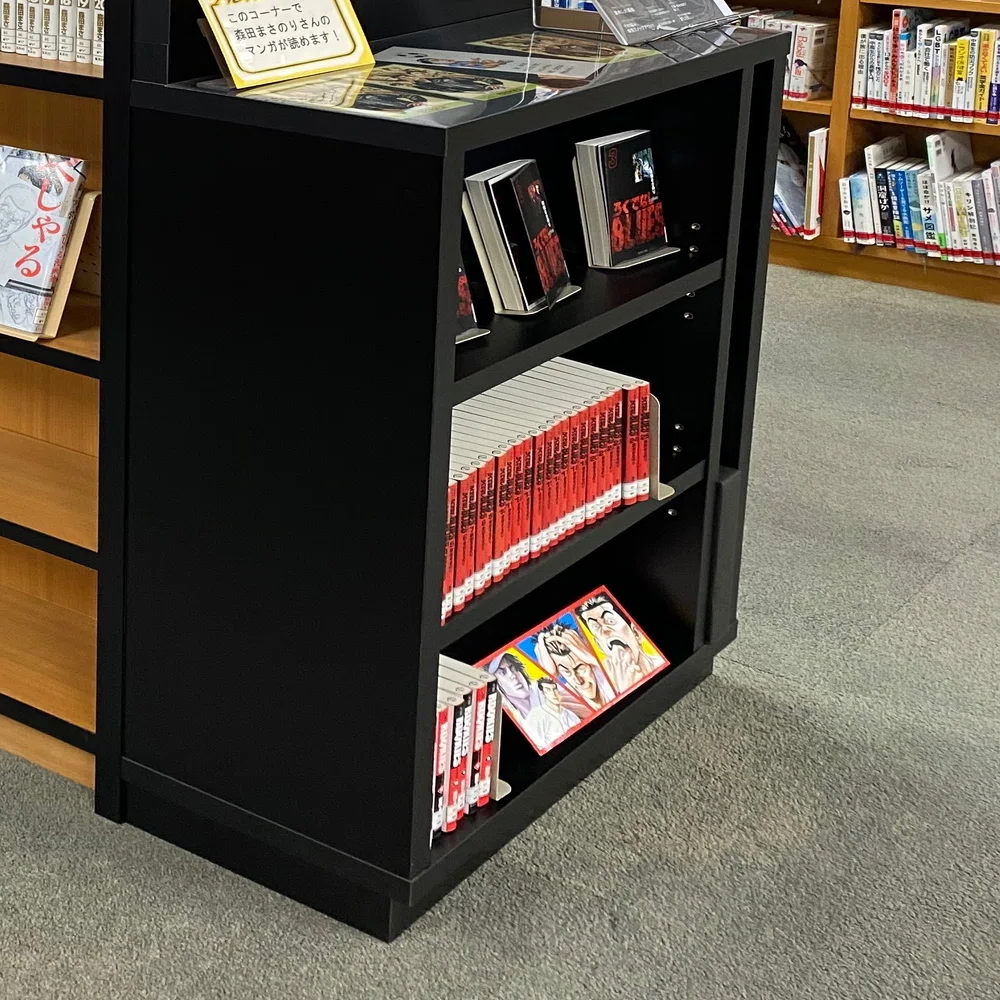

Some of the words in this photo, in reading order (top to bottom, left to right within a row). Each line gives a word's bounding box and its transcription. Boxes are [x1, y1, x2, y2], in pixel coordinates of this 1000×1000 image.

[227, 2, 303, 23] このコーナーで
[233, 15, 331, 41] 森田まさのりさんの
